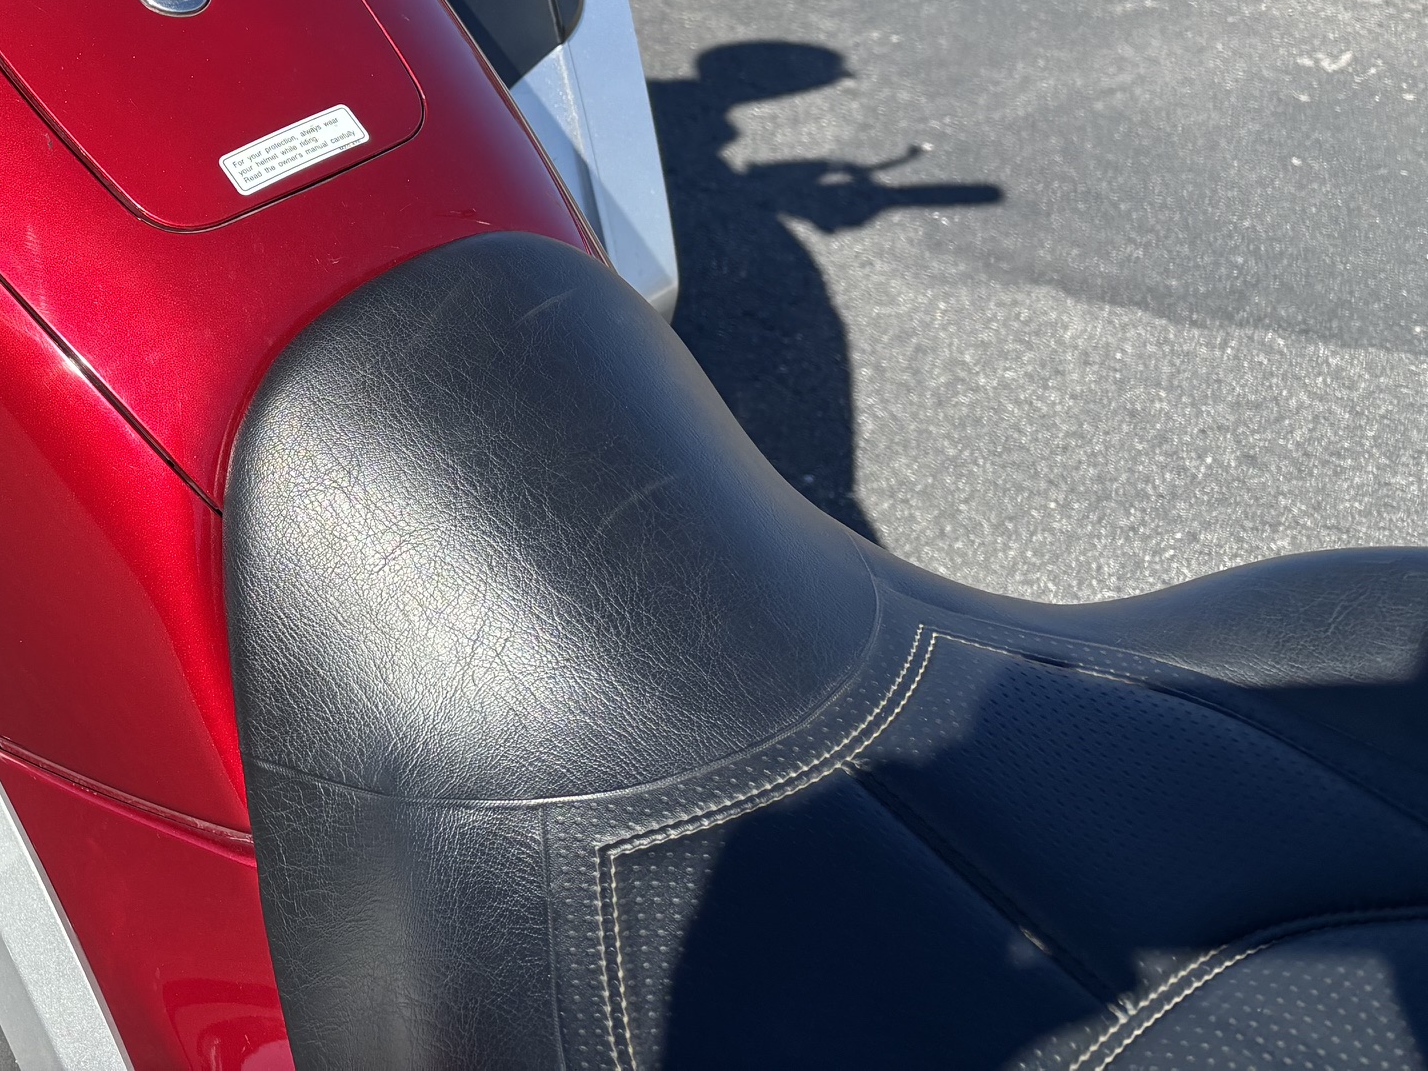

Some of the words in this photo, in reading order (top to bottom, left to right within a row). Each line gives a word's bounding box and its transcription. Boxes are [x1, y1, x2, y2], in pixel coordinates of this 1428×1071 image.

[233, 159, 245, 168] For
[247, 150, 263, 162] your
[264, 135, 299, 154] protection,
[299, 124, 322, 138] always
[323, 117, 339, 127] wear
[238, 165, 253, 177] your
[255, 154, 279, 167] helmet
[280, 144, 297, 156] while
[243, 172, 263, 184] Read
[264, 165, 276, 174] the
[278, 153, 304, 167] owner's
[305, 141, 329, 155] manual
